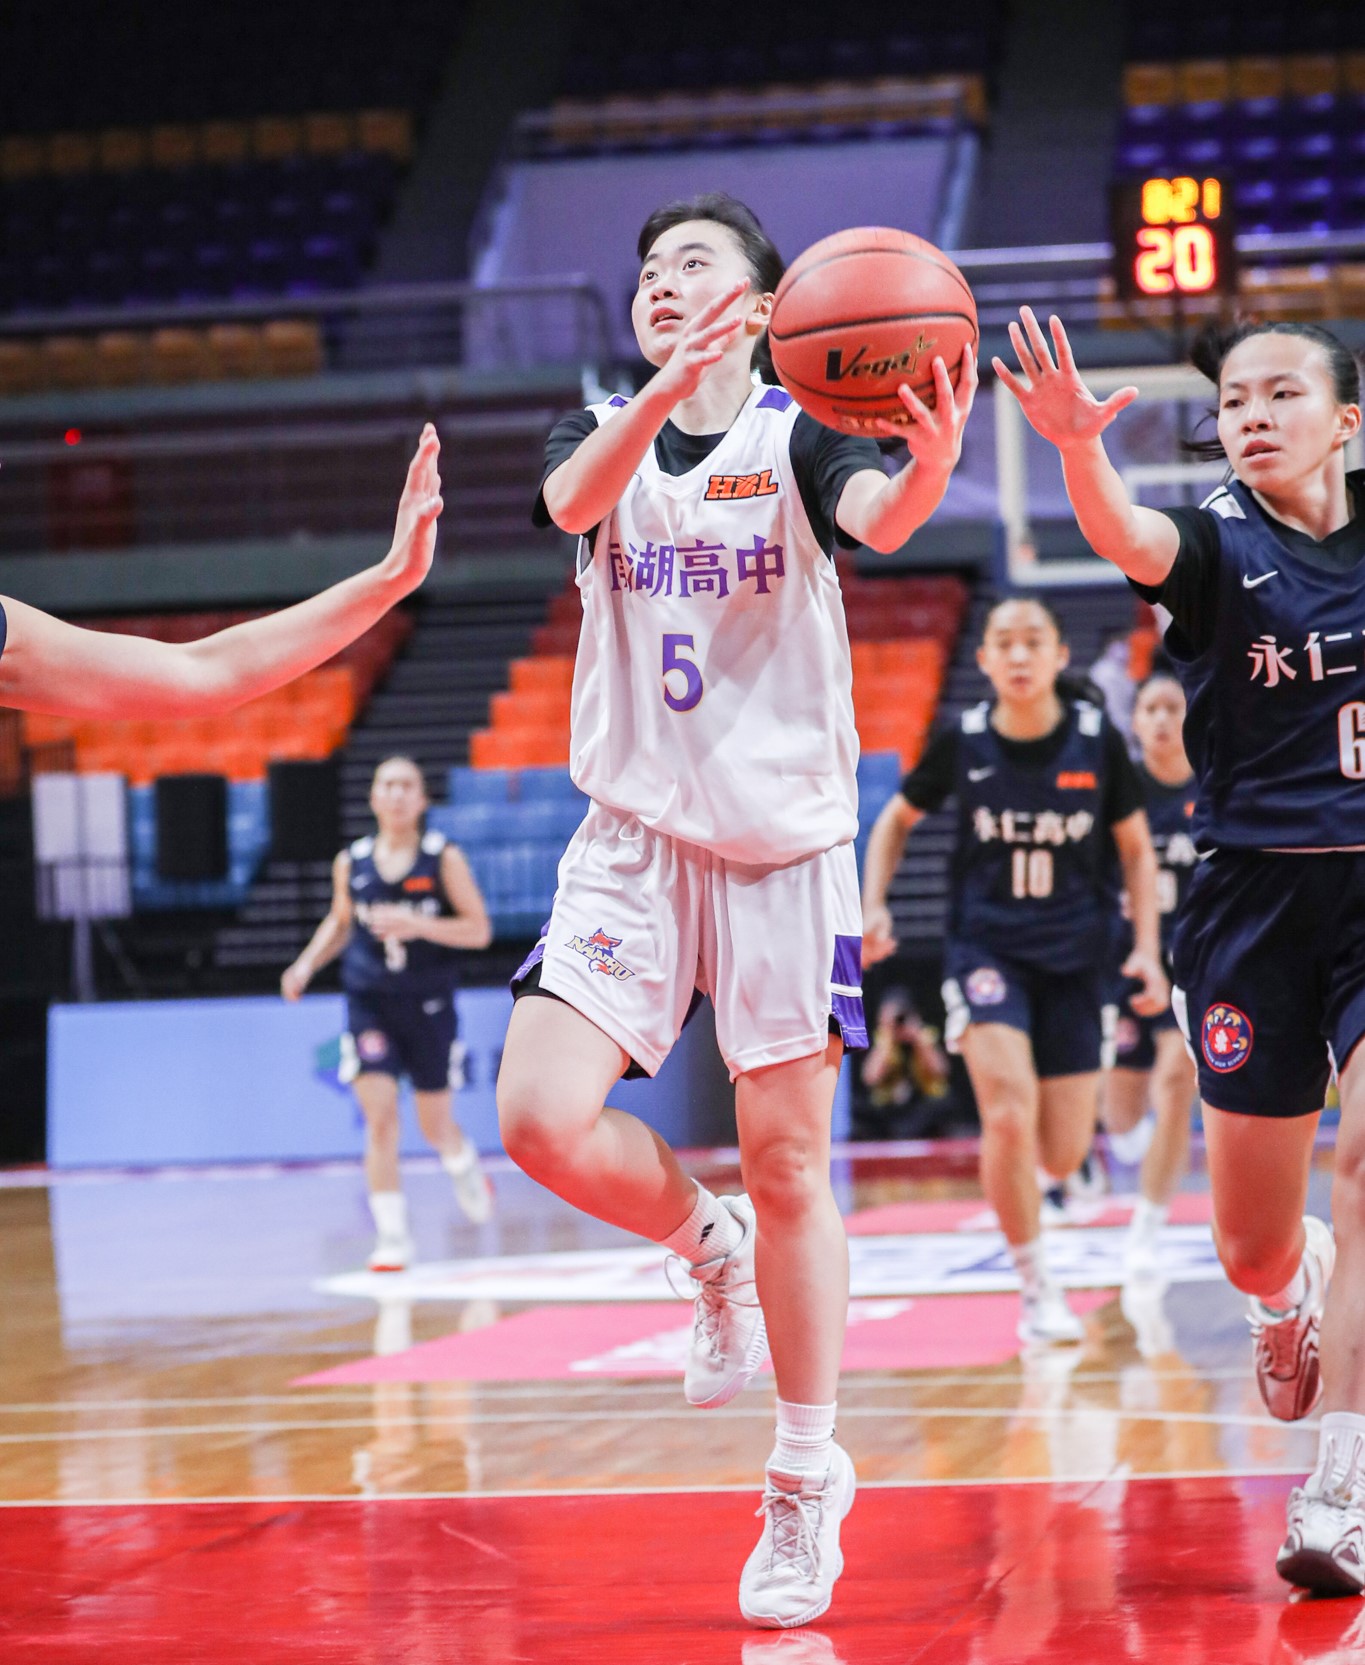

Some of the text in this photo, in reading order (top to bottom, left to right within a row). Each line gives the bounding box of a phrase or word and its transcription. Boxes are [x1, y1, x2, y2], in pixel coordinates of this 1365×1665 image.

[1136, 226, 1215, 294] 20
[662, 633, 704, 713] 5
[1247, 631, 1365, 688] 永仁
[1012, 848, 1053, 899] 10
